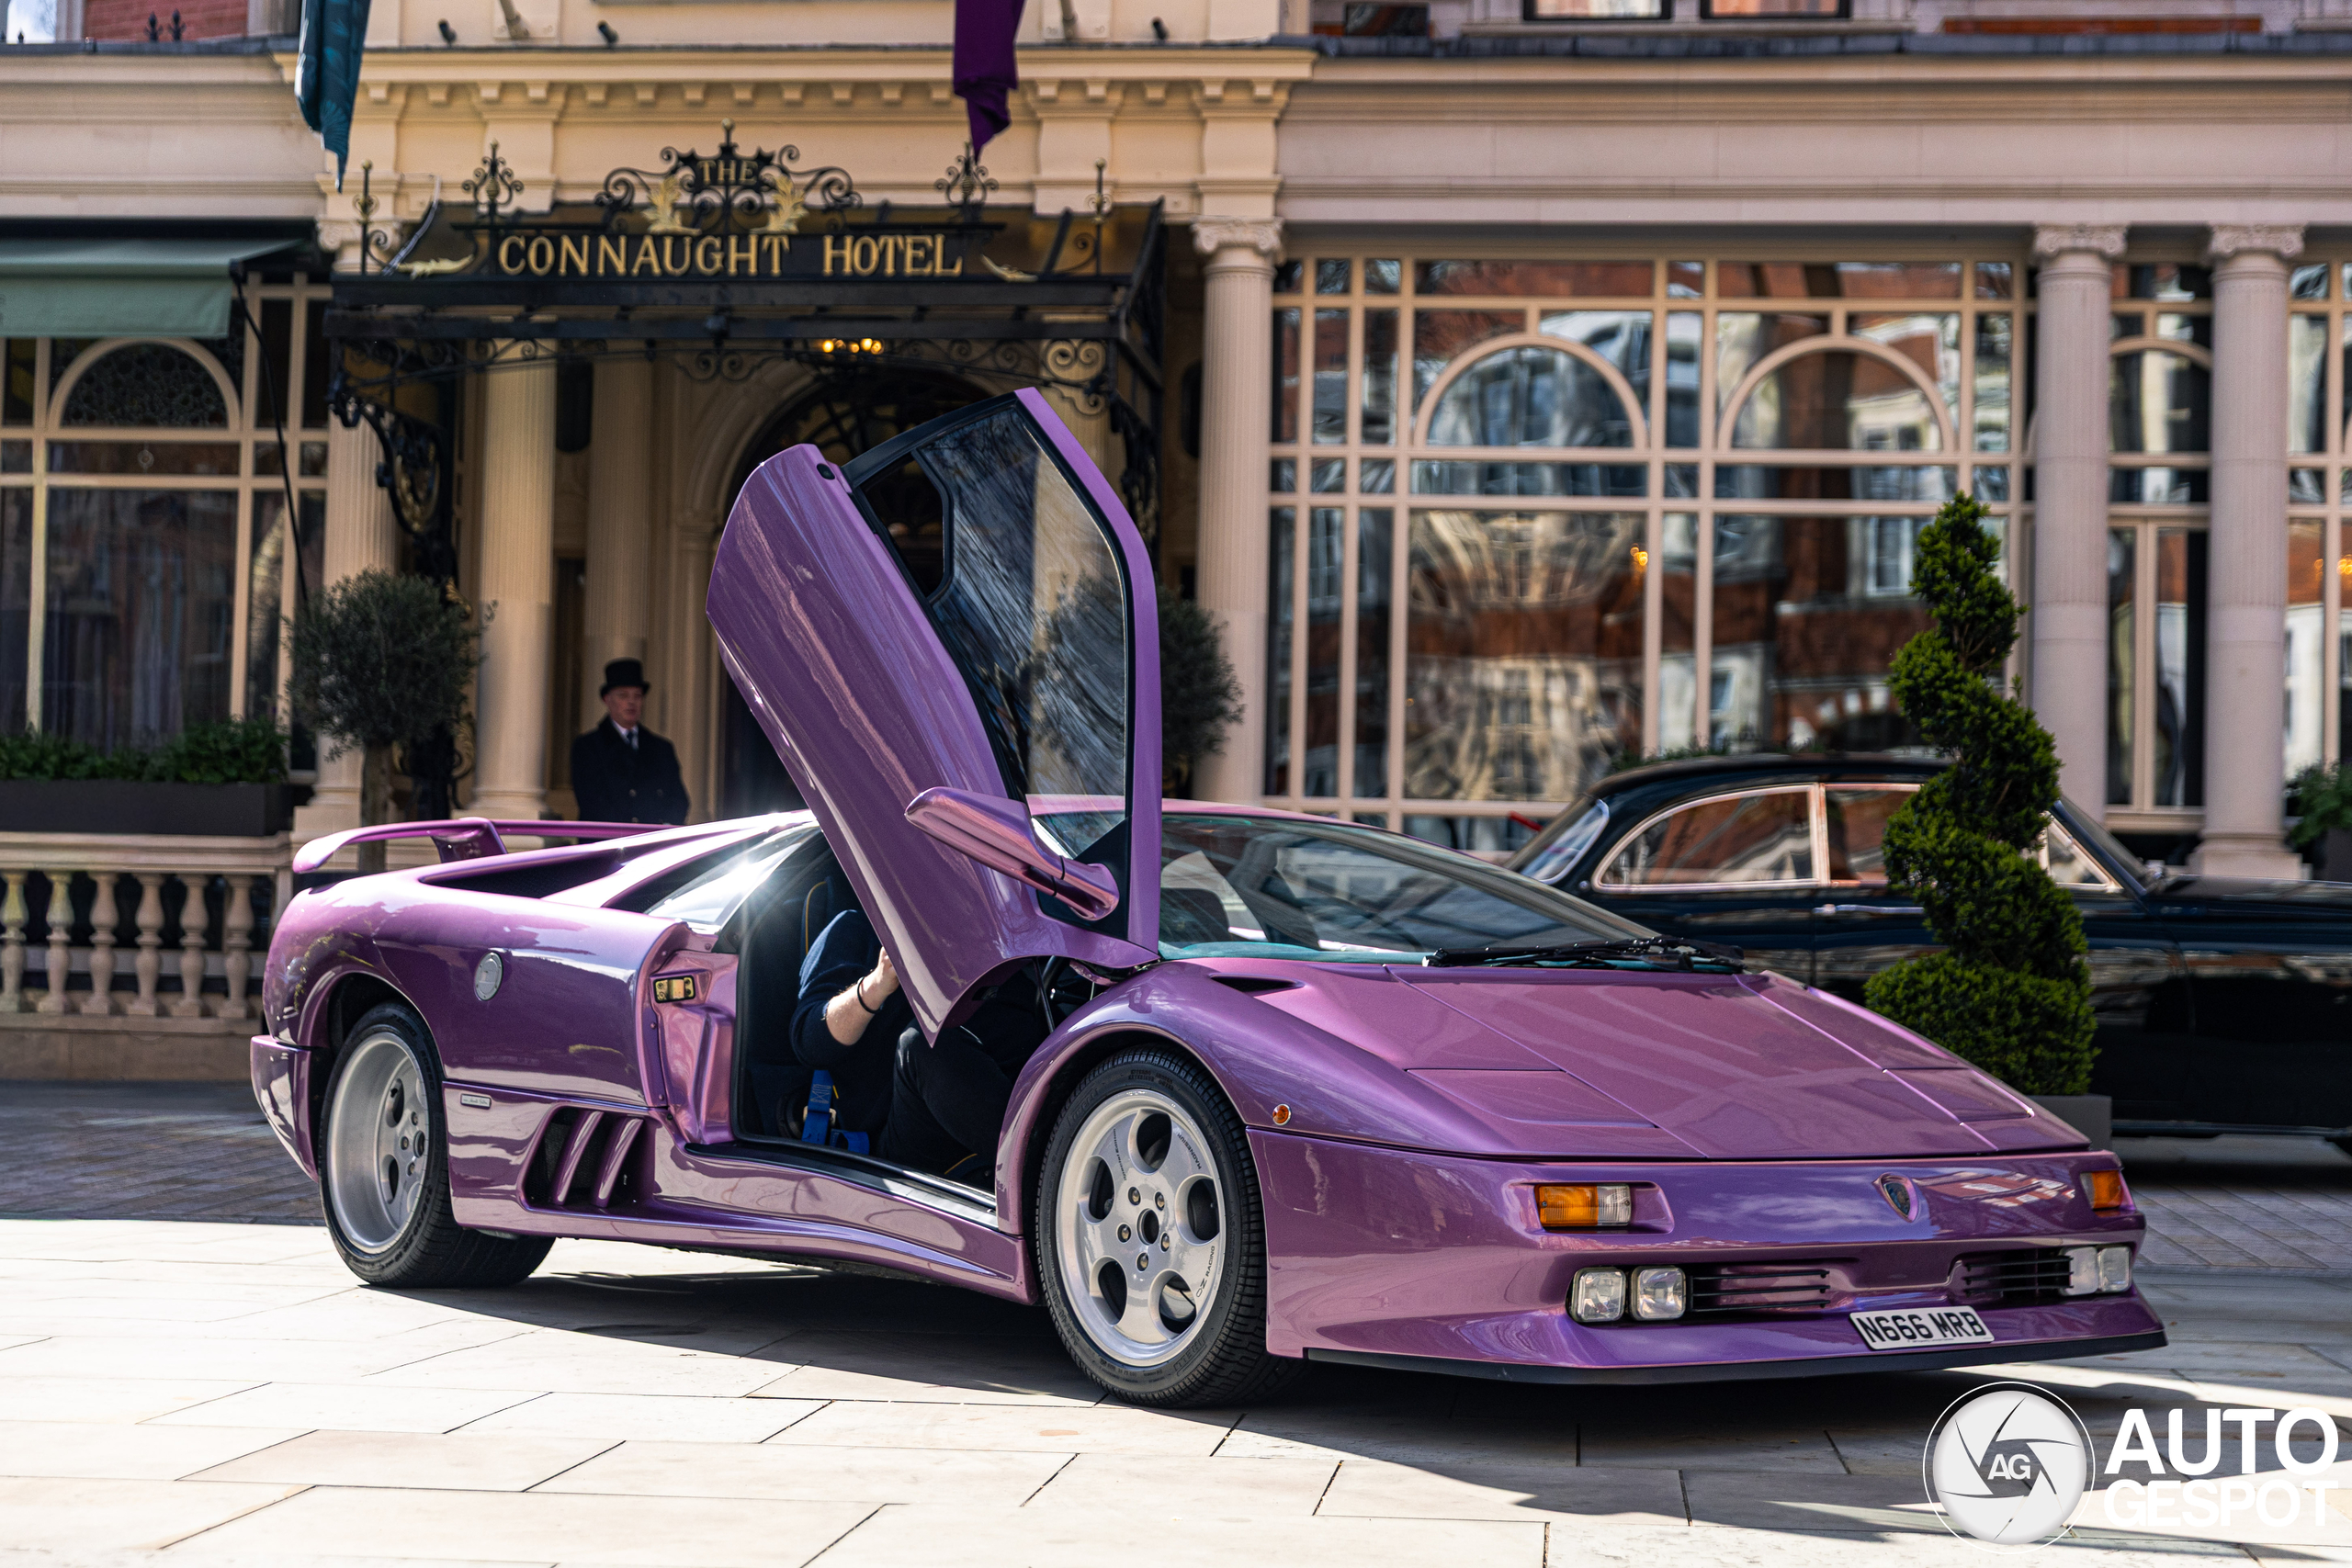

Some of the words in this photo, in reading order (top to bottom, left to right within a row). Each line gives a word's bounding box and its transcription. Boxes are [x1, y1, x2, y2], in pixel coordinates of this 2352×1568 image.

[697, 159, 759, 186] THE
[498, 234, 790, 276] CONNAUGHT
[822, 233, 963, 276] HOTEL
[1177, 1133, 1202, 1169] MAGNESIUM
[1195, 1278, 1207, 1298] OZ
[1205, 1246, 1216, 1277] RACING
[1856, 1314, 1934, 1343] N666
[1928, 1312, 1987, 1338] MRB
